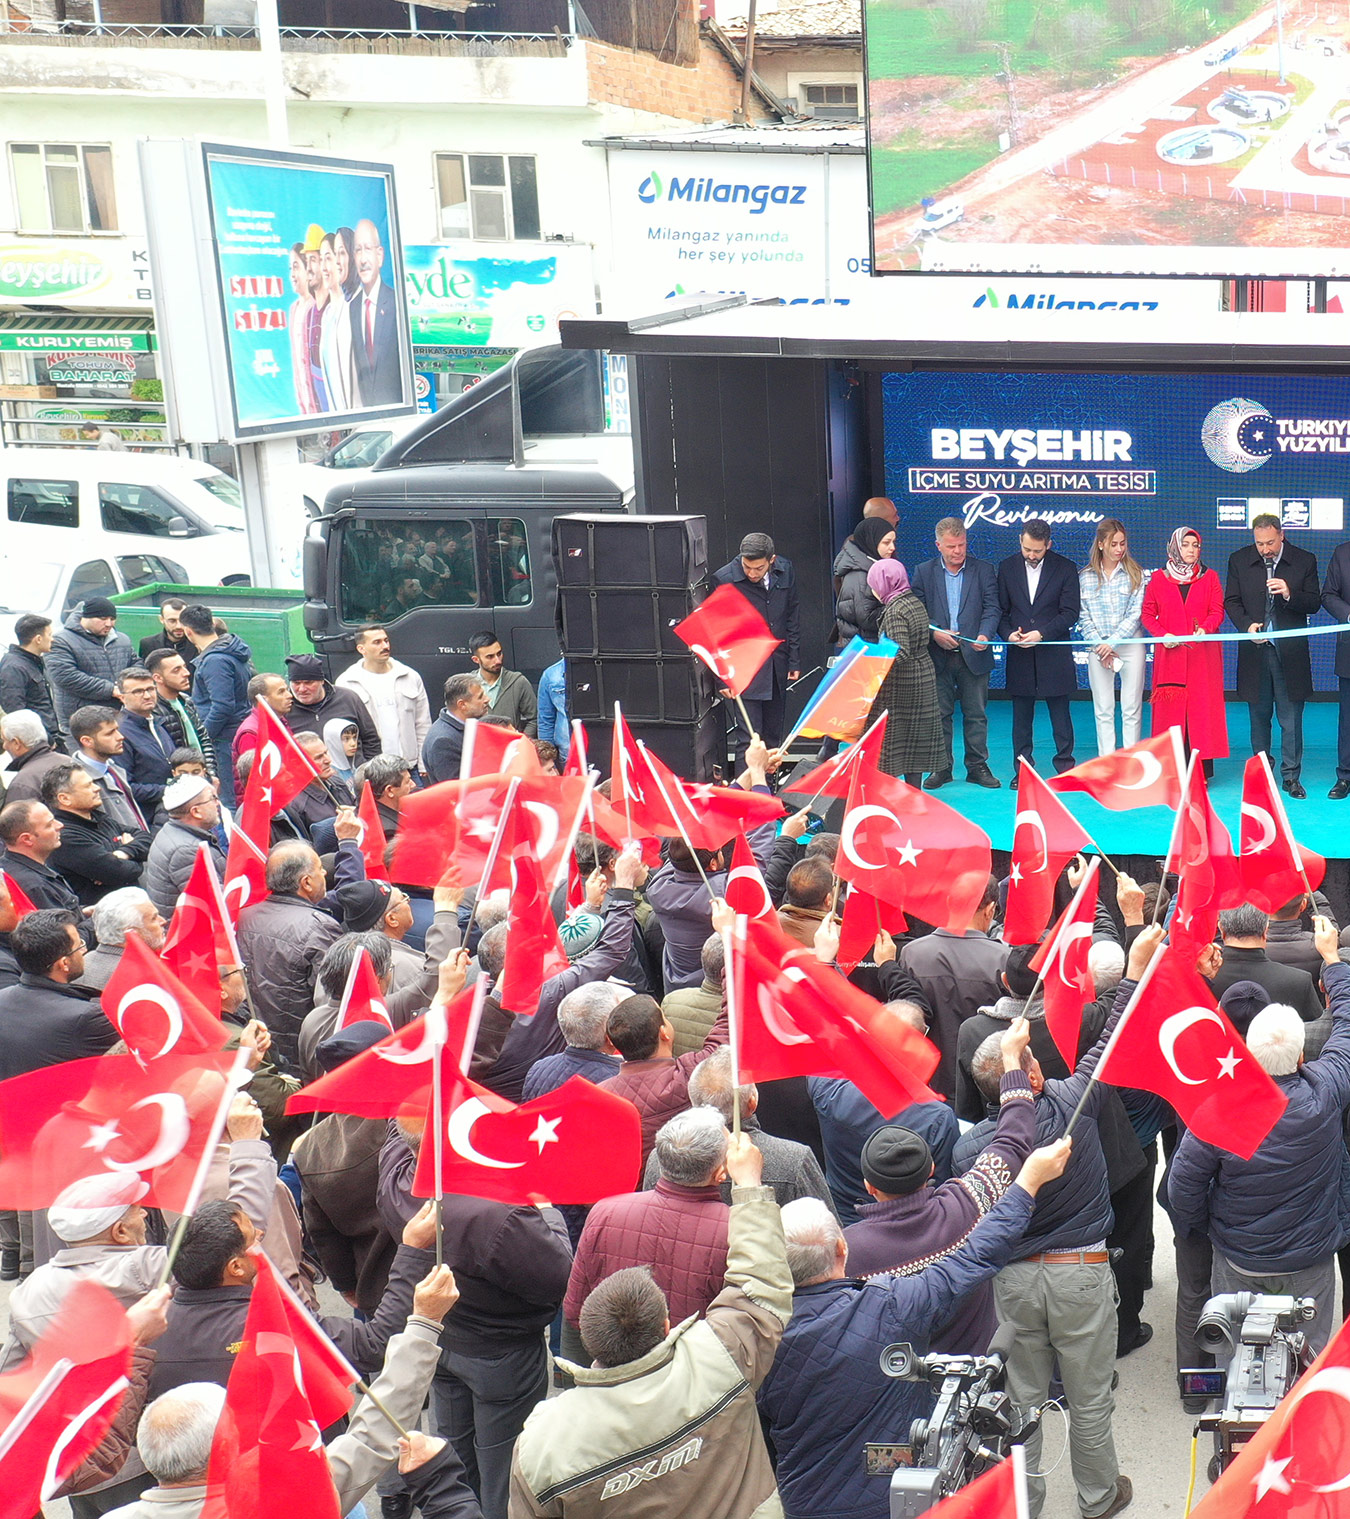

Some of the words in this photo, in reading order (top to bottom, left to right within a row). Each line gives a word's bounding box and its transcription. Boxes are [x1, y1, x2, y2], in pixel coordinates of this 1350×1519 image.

[668, 177, 807, 214] Milangaz
[647, 227, 720, 244] Milangaz
[725, 230, 789, 244] yanında
[678, 247, 703, 260] her
[709, 250, 735, 263] şey
[741, 249, 804, 263] yolunda
[0, 257, 106, 289] eyşehir
[407, 256, 471, 305] yde
[231, 275, 284, 298] SANA
[16, 336, 133, 350] KURUYEMİŞ
[442, 347, 468, 356] SATIŞ
[50, 370, 136, 382] BAHARAT
[916, 470, 960, 490] İÇME
[965, 473, 1015, 490] SUYU
[1019, 473, 1092, 490] ARITMA
[1095, 471, 1150, 490] TESİSİ
